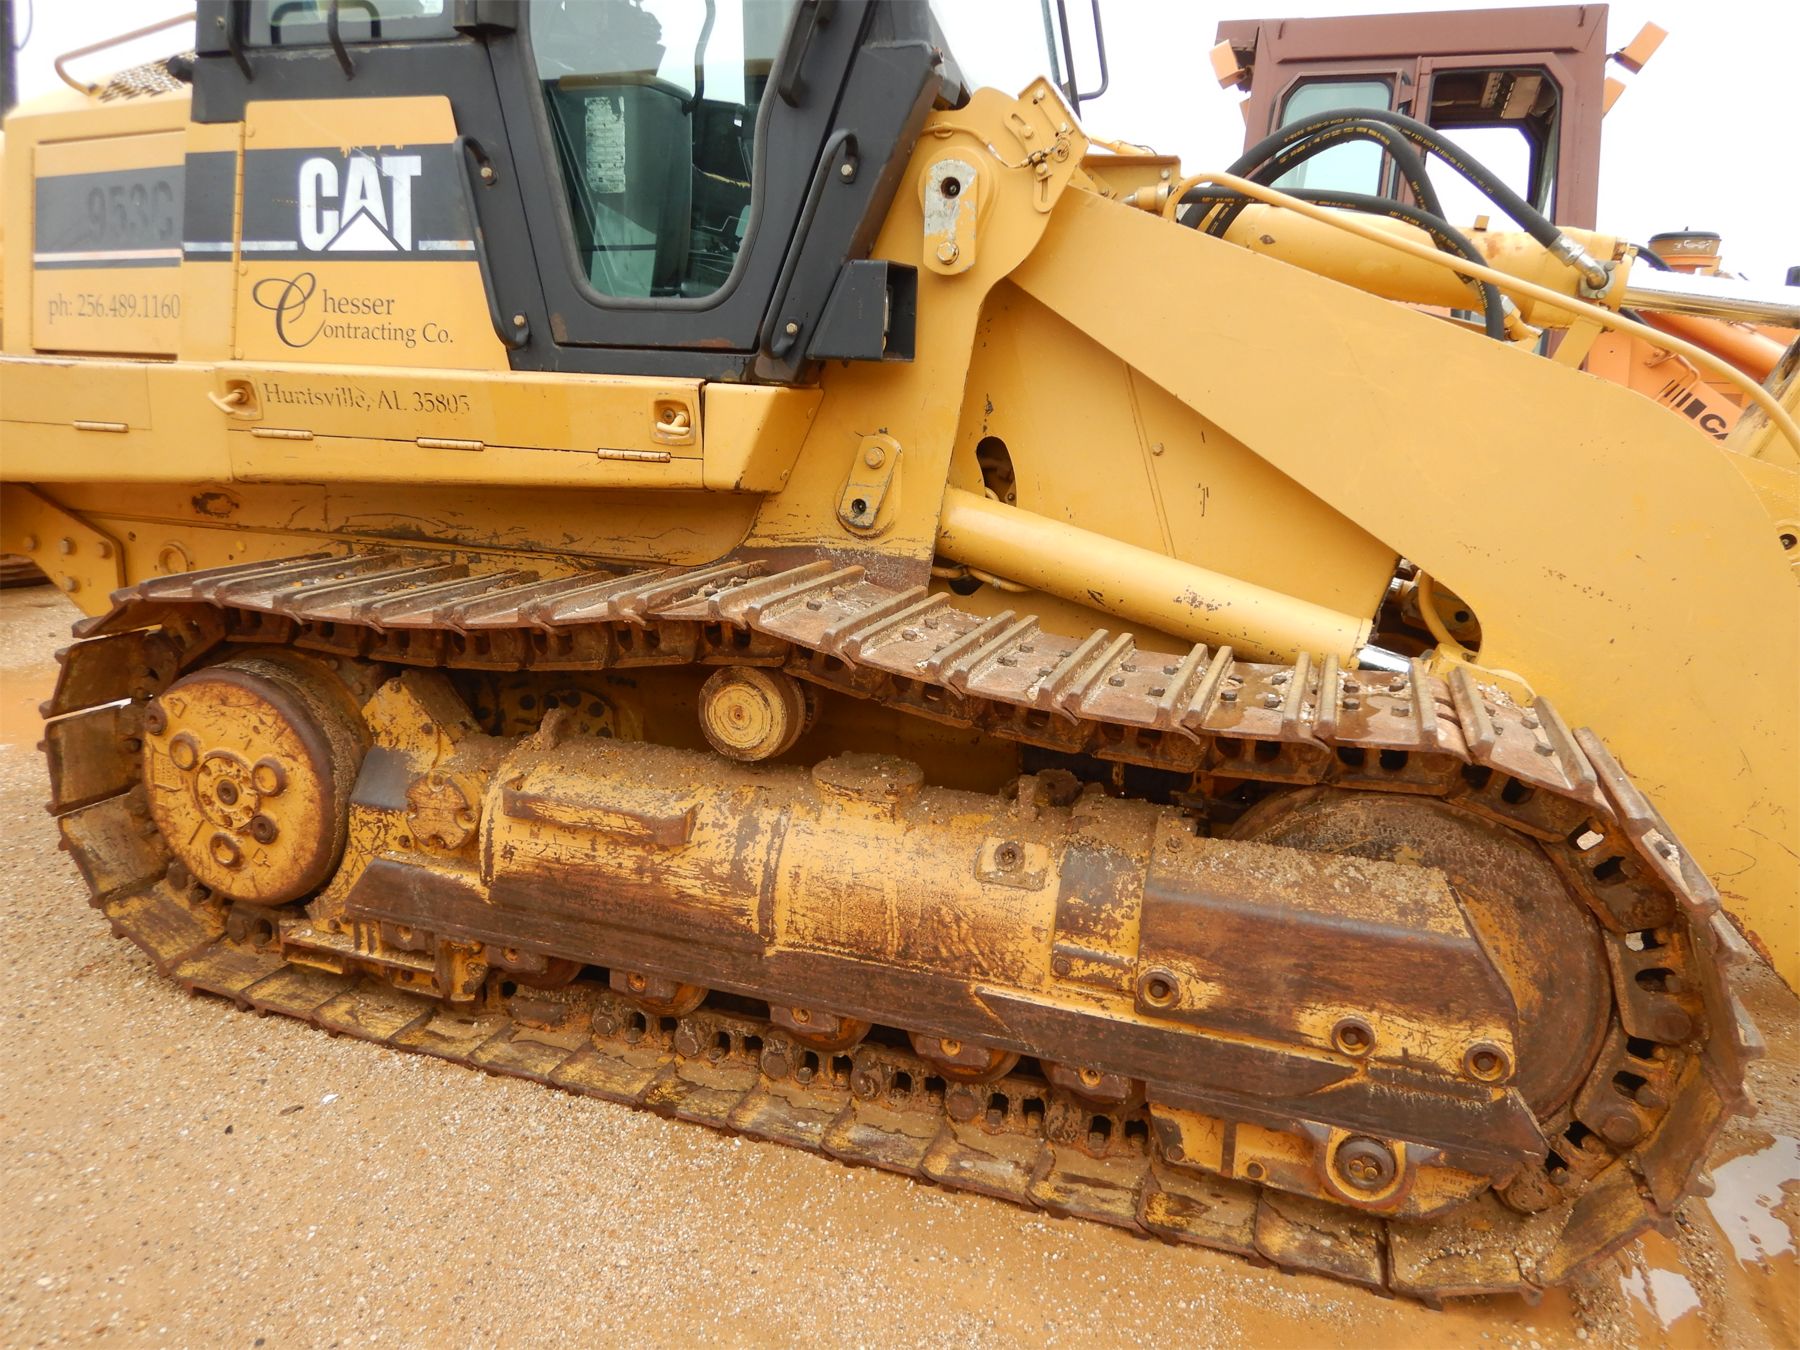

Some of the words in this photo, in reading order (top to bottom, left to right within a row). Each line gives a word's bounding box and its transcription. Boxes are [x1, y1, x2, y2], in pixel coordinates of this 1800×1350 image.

[87, 180, 174, 240] 953C
[299, 155, 422, 252] CAT
[48, 292, 73, 325] ph:
[77, 294, 181, 319] 256.489.1160
[422, 322, 454, 344] Co.
[264, 383, 371, 412] Huntsville,
[413, 391, 470, 414] 35805
